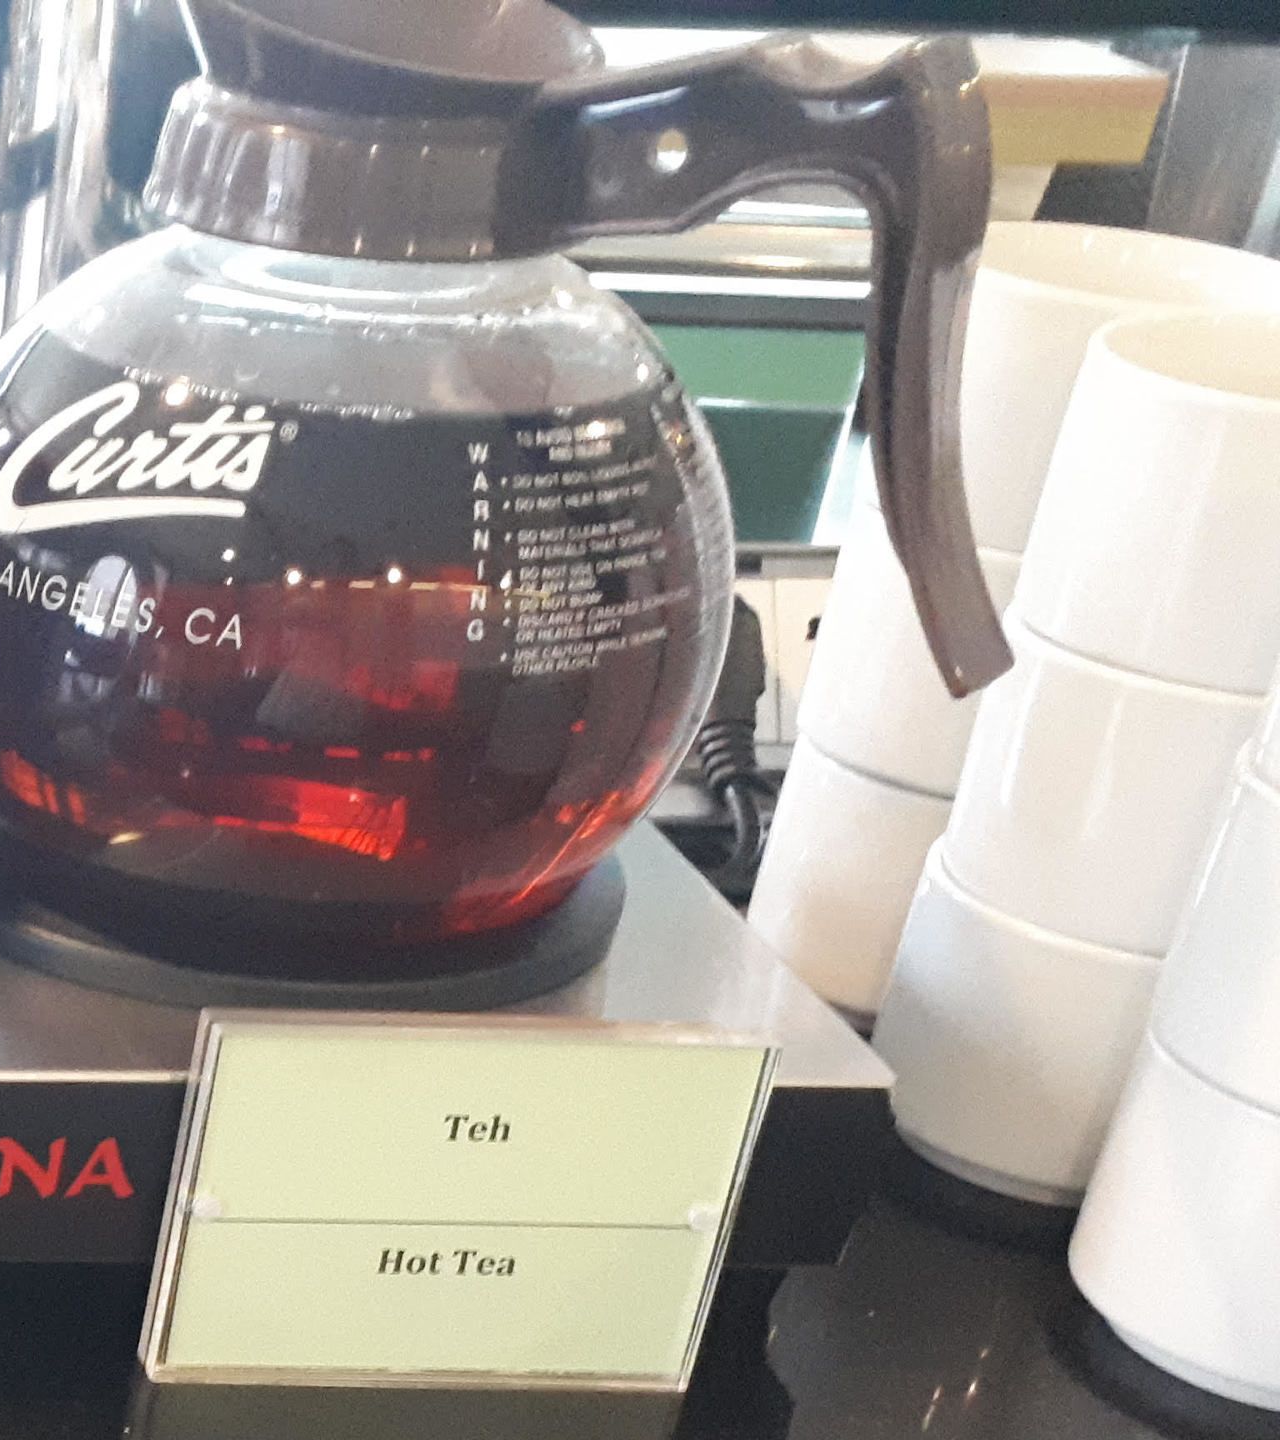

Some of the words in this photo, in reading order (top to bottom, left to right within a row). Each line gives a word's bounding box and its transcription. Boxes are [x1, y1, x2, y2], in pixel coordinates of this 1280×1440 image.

[184, 607, 243, 651] CA
[444, 1114, 511, 1143] Teh
[376, 1248, 442, 1276] Hot
[453, 1250, 516, 1277] Tea
